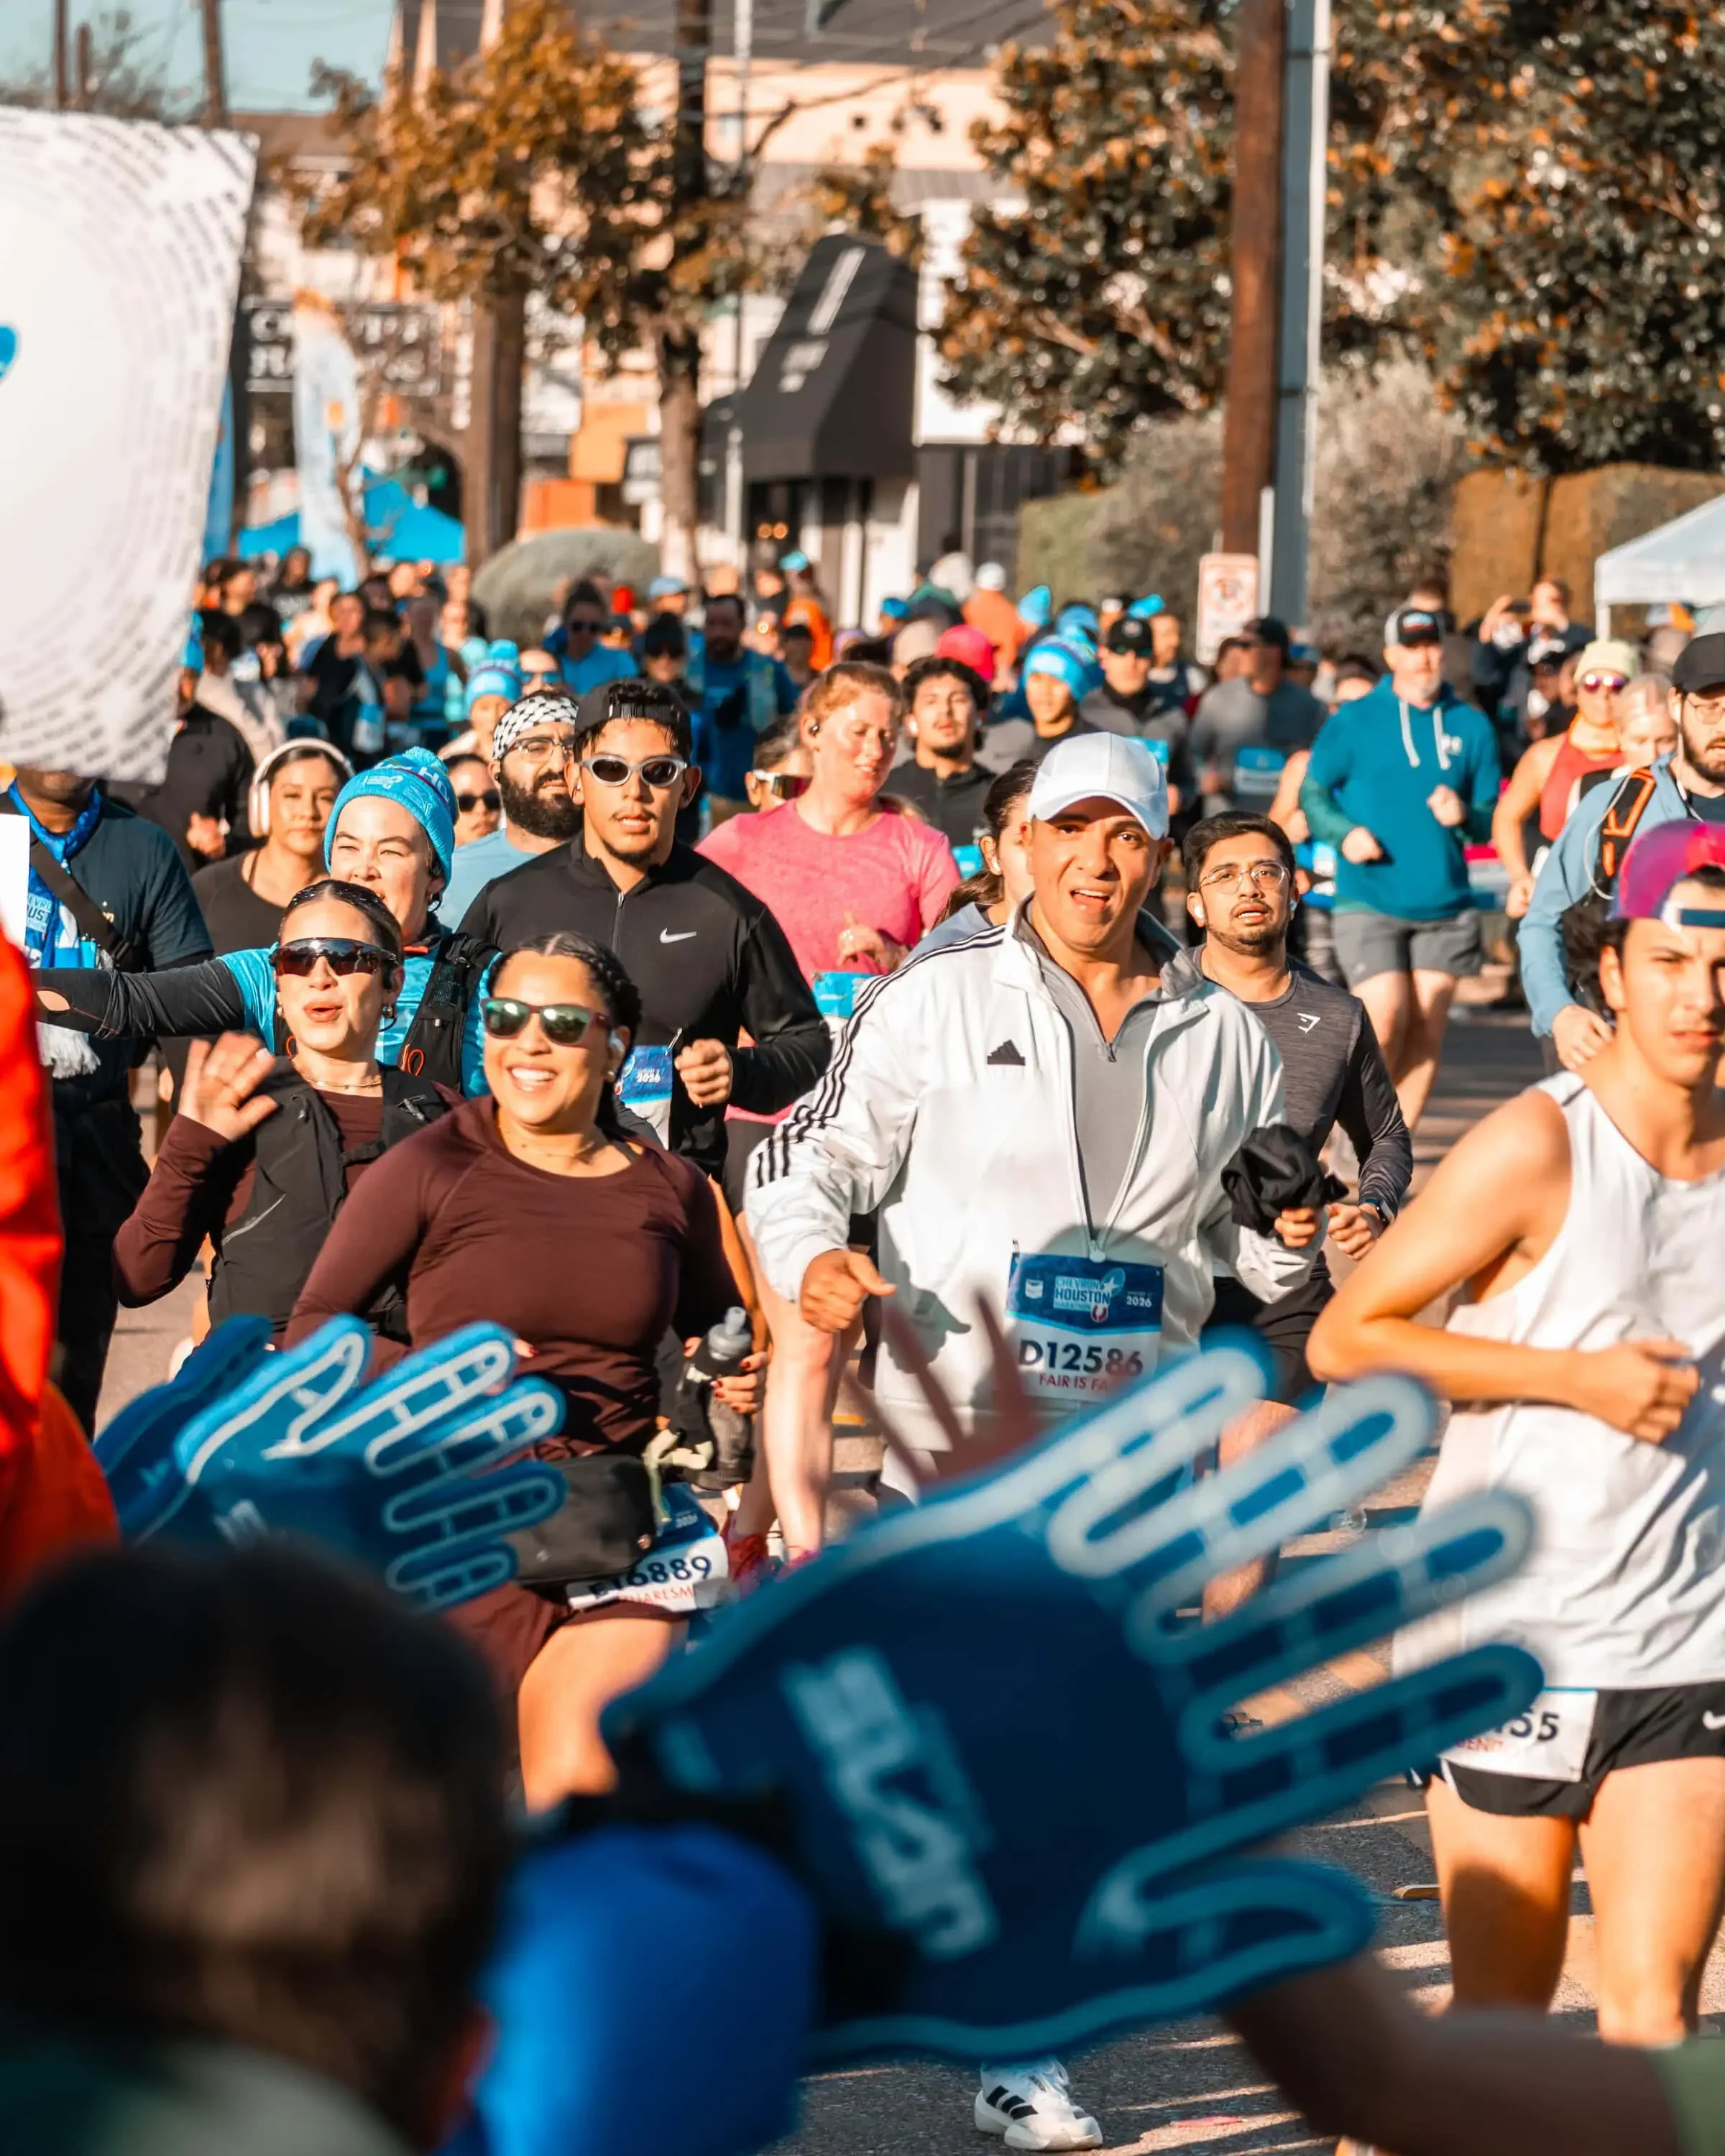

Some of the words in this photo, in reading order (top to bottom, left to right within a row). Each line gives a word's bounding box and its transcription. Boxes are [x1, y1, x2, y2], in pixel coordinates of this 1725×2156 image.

[1054, 1287, 1110, 1304] HOUSTON
[1126, 1296, 1152, 1308] 2026
[1018, 1339, 1144, 1376] D12586
[1039, 1372, 1070, 1388] FAIR
[1074, 1376, 1087, 1389] IS
[1091, 1378, 1108, 1391] FA
[1508, 1707, 1560, 1741] 55
